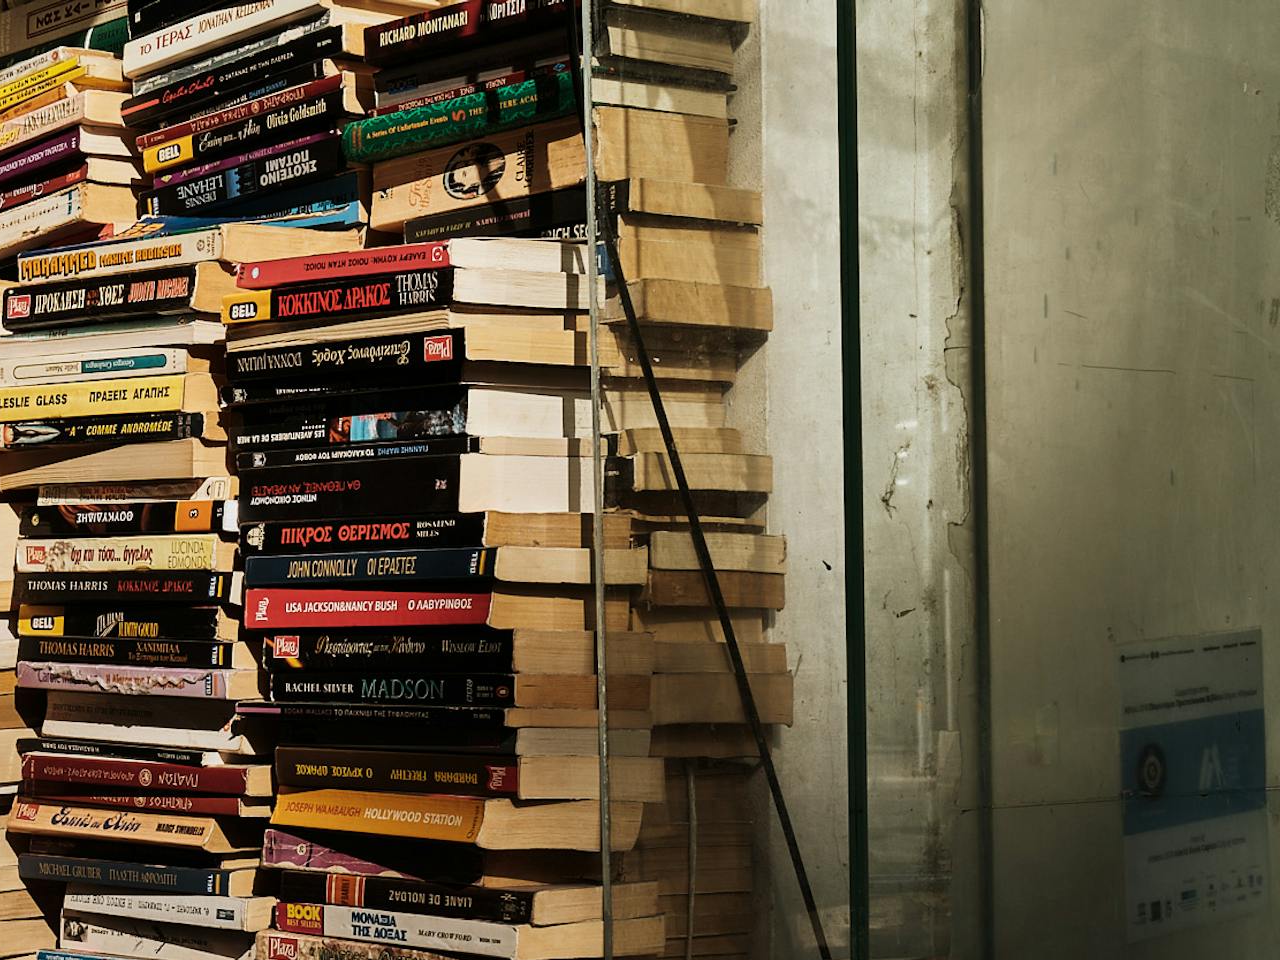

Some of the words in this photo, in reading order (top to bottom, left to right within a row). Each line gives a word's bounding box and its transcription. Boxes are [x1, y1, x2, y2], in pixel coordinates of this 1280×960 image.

[155, 25, 193, 50] ΤΕΡΑΣ
[198, 10, 234, 34] JONATHAN
[379, 25, 415, 47] RICHARD
[418, 11, 468, 37] MONTANARI
[267, 110, 289, 130] Olivia
[289, 98, 327, 124] Goldsmith
[469, 106, 484, 117] THE
[430, 115, 448, 126] Events
[265, 150, 310, 173] ΠΟΤΑΜΙ
[260, 159, 317, 187] ΣΚΟΤΕΙΝΟ
[177, 175, 223, 200] LEHANE
[185, 194, 217, 209] DENNIS
[21, 251, 97, 281] MOHAMMED
[100, 251, 133, 268] MAXIME
[395, 272, 438, 292] THOMAS
[35, 288, 86, 315] ΠΡΟΚΛΗΣΗ
[278, 289, 342, 317] ΚΟΚΚΙΝΟΣ
[345, 283, 391, 310] ΔΡΑΚΟΣ
[399, 291, 436, 305] HARRIS
[230, 304, 256, 319] BELL
[311, 347, 345, 366] Χορός
[426, 337, 451, 360] Plaza
[268, 351, 302, 369] DONNA
[36, 394, 67, 406] GLASS
[89, 389, 128, 403] ΠΡΑΞΕΙΣ
[133, 386, 170, 400] ΑΓΑΠΗΣ
[86, 424, 118, 436] COMME
[76, 511, 134, 524] ΘΟΥΚΥΔΙΔΗΣ
[281, 525, 332, 547] ΠΙΚΡΟΣ
[338, 522, 410, 542] ΘΕΡΙΣΜΟΣ
[171, 541, 204, 554] LUCINDA
[287, 561, 310, 578] JOHN
[311, 558, 358, 576] CONNOLLY
[378, 556, 417, 575] ΕΡΑΣΤΕΣ
[27, 581, 66, 590] THOMAS
[70, 581, 108, 591] HARRIS
[117, 581, 160, 592] ΚΟΚΚΙΝΟΣ
[162, 581, 193, 592] ΔΡΑΚΟΣ
[285, 602, 302, 613] LISA
[303, 600, 373, 613] JACKSON&NANCY
[375, 600, 397, 611] BUSH
[415, 598, 472, 610] ΛΑΒΥΡΙΝΘΟΣ
[39, 641, 80, 655] THOMAS
[82, 643, 115, 656] HARRIS
[441, 640, 475, 653] WINSLOW
[478, 638, 502, 653] ELIOT
[285, 682, 321, 693] RACHEL
[323, 683, 354, 693] SILVER
[360, 679, 444, 699] MADSON
[158, 772, 199, 788] ΠΛΑΤΩΝ
[390, 771, 427, 781] FREETHY
[434, 772, 478, 784] BARBARA
[285, 801, 314, 814] JOSEPH
[315, 804, 361, 817] WAMBAUGH
[364, 808, 420, 823] HOLLYWOOD
[423, 811, 462, 827] STATION
[39, 862, 70, 876] MICHAEL
[73, 865, 101, 880] GRUBER
[429, 893, 440, 903] DE
[445, 896, 472, 908] LIANE
[287, 904, 320, 921] BOOK
[352, 912, 396, 927] ΜΟΝΑΞΙΑ
[352, 925, 371, 937] ΤΗΣ
[374, 927, 407, 941] ΔΟΞΑΣ
